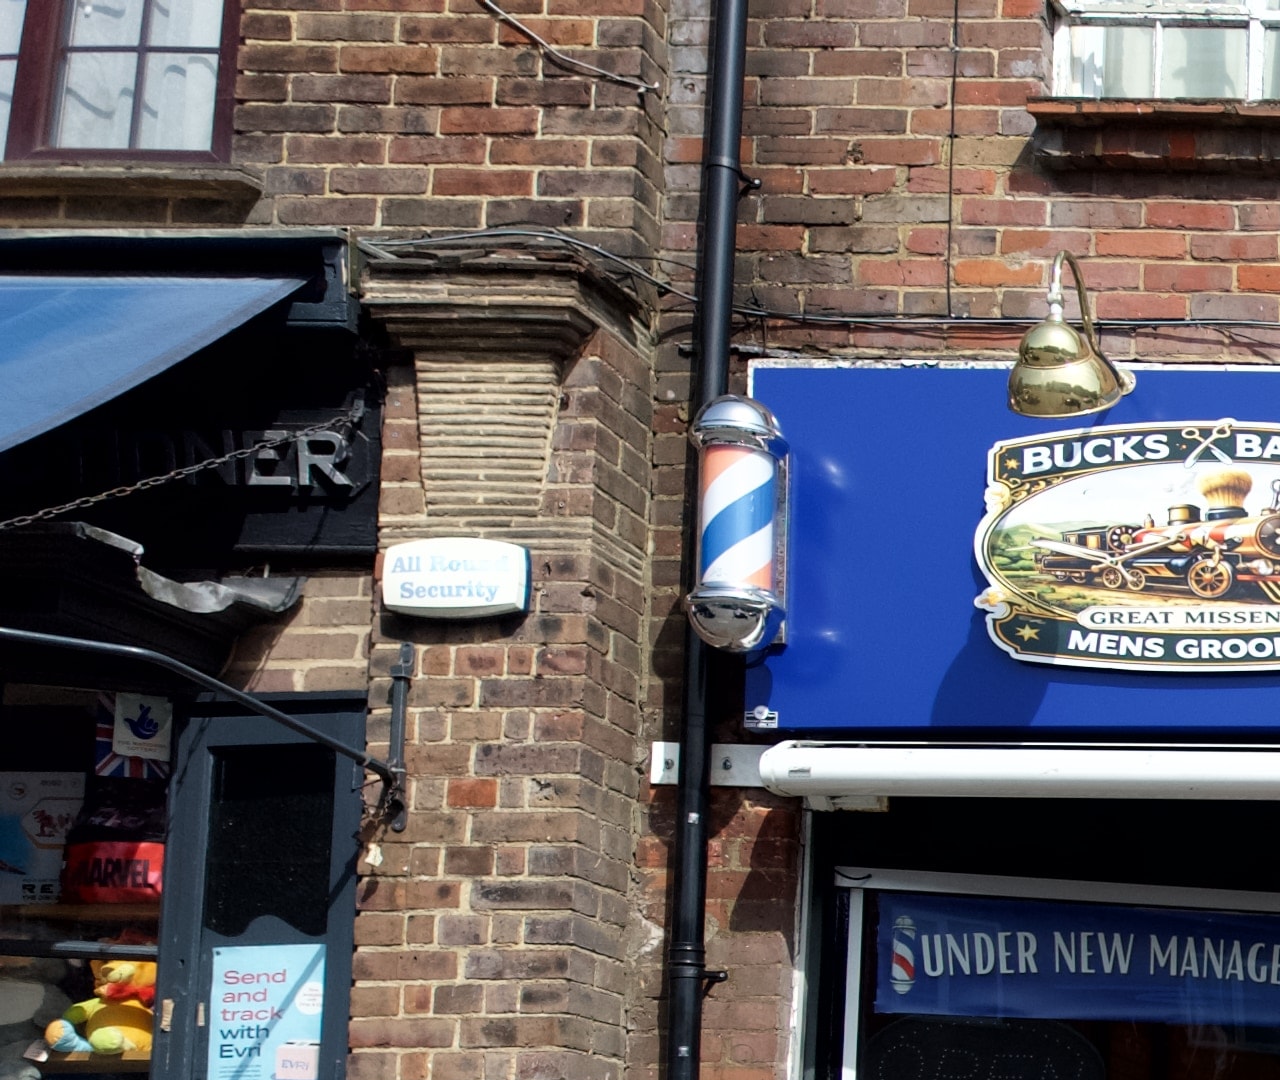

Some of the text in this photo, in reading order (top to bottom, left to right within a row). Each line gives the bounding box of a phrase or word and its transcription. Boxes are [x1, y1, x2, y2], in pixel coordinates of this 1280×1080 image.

[1021, 433, 1170, 476] BUCKS
[391, 556, 422, 574] All
[400, 580, 500, 603] Security
[1089, 610, 1175, 627] GREAT
[1067, 629, 1165, 659] MENS
[921, 931, 1038, 977] UNDER
[1053, 930, 1135, 975] NEW
[223, 968, 287, 985] Send
[222, 987, 267, 1004] and
[221, 1006, 284, 1022] track
[219, 1024, 270, 1040] with
[219, 1043, 261, 1059] Evri
